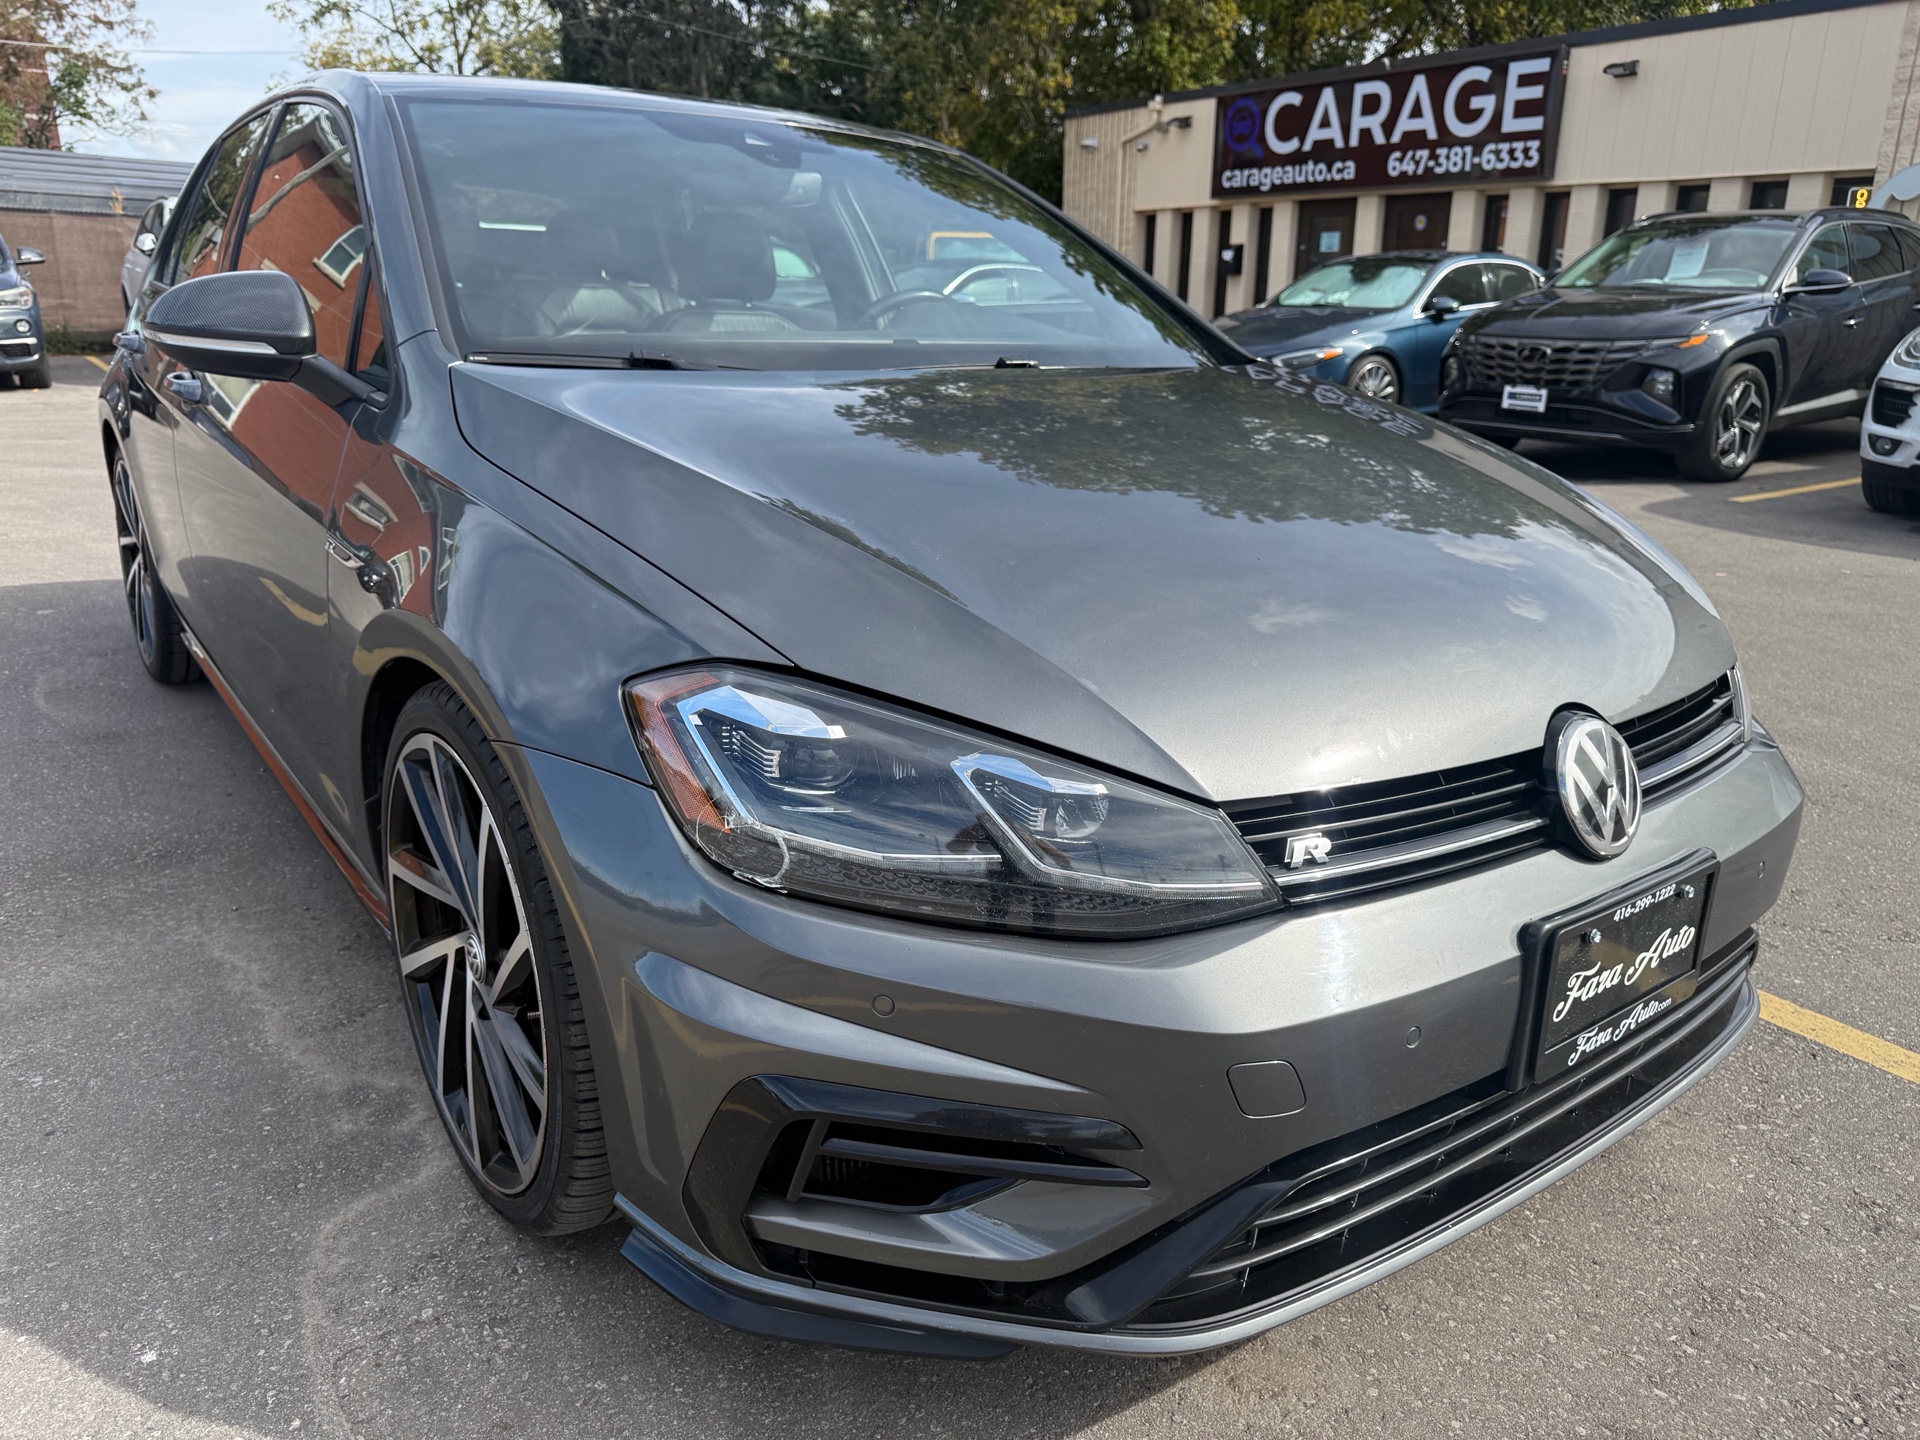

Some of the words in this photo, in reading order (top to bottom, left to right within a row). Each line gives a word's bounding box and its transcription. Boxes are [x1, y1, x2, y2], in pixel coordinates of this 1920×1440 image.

[1264, 57, 1552, 155] CARAGE
[1221, 159, 1356, 192] carageauto.ca
[1387, 139, 1541, 177] 647-381-6333
[1285, 832, 1332, 868] R
[1613, 883, 1676, 922] 416-299-1222
[1553, 961, 1624, 1022] Fara
[1624, 925, 1695, 986] Auto
[1568, 1026, 1613, 1066] Fara
[1613, 998, 1672, 1042] Auto.com
